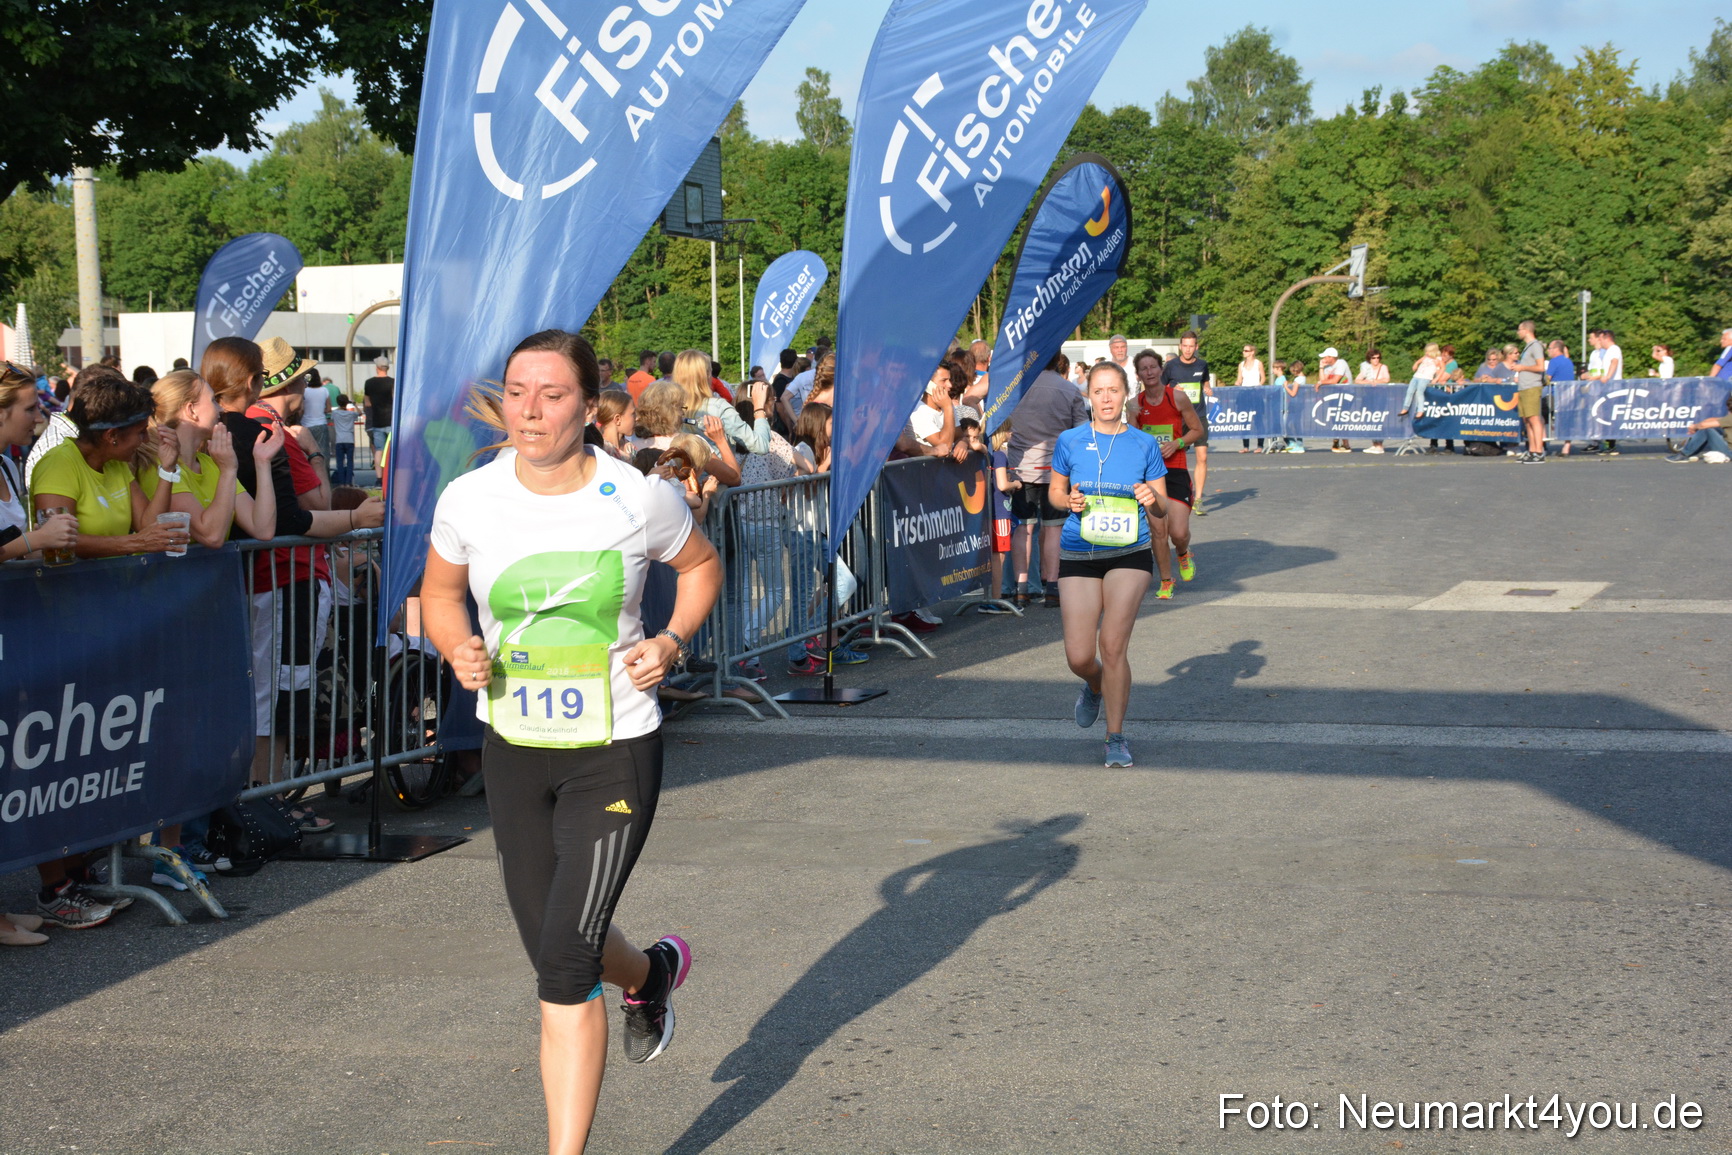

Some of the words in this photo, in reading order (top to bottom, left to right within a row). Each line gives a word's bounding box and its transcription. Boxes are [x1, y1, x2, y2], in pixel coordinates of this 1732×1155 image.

[535, 0, 682, 144] Fis
[916, 0, 1072, 213] Fische
[973, 2, 1097, 209] AUTOMOBILE
[219, 250, 279, 329] Fischer
[1060, 275, 1083, 305] Druck
[1096, 228, 1124, 267] Medien
[240, 264, 287, 328] AUTOMOBILE
[769, 264, 811, 328] Fischer
[784, 275, 816, 326] AUTOMOBILE
[1004, 241, 1093, 351] Frischmann
[1325, 407, 1389, 423] Fischer
[1460, 417, 1480, 425] Druck
[1481, 418, 1494, 426] und
[1494, 418, 1520, 427] Medien
[1611, 402, 1702, 421] Fischer
[1619, 420, 1694, 430] AUTOMOBILE
[1081, 480, 1093, 488] WER
[892, 503, 965, 548] Frischmann
[938, 540, 955, 560] Druck
[954, 536, 970, 555] und
[1088, 515, 1131, 533] 1551
[0, 683, 165, 770] cher
[512, 686, 584, 719] 119
[519, 723, 546, 733] Claudia
[0, 760, 146, 823] OMOBILE
